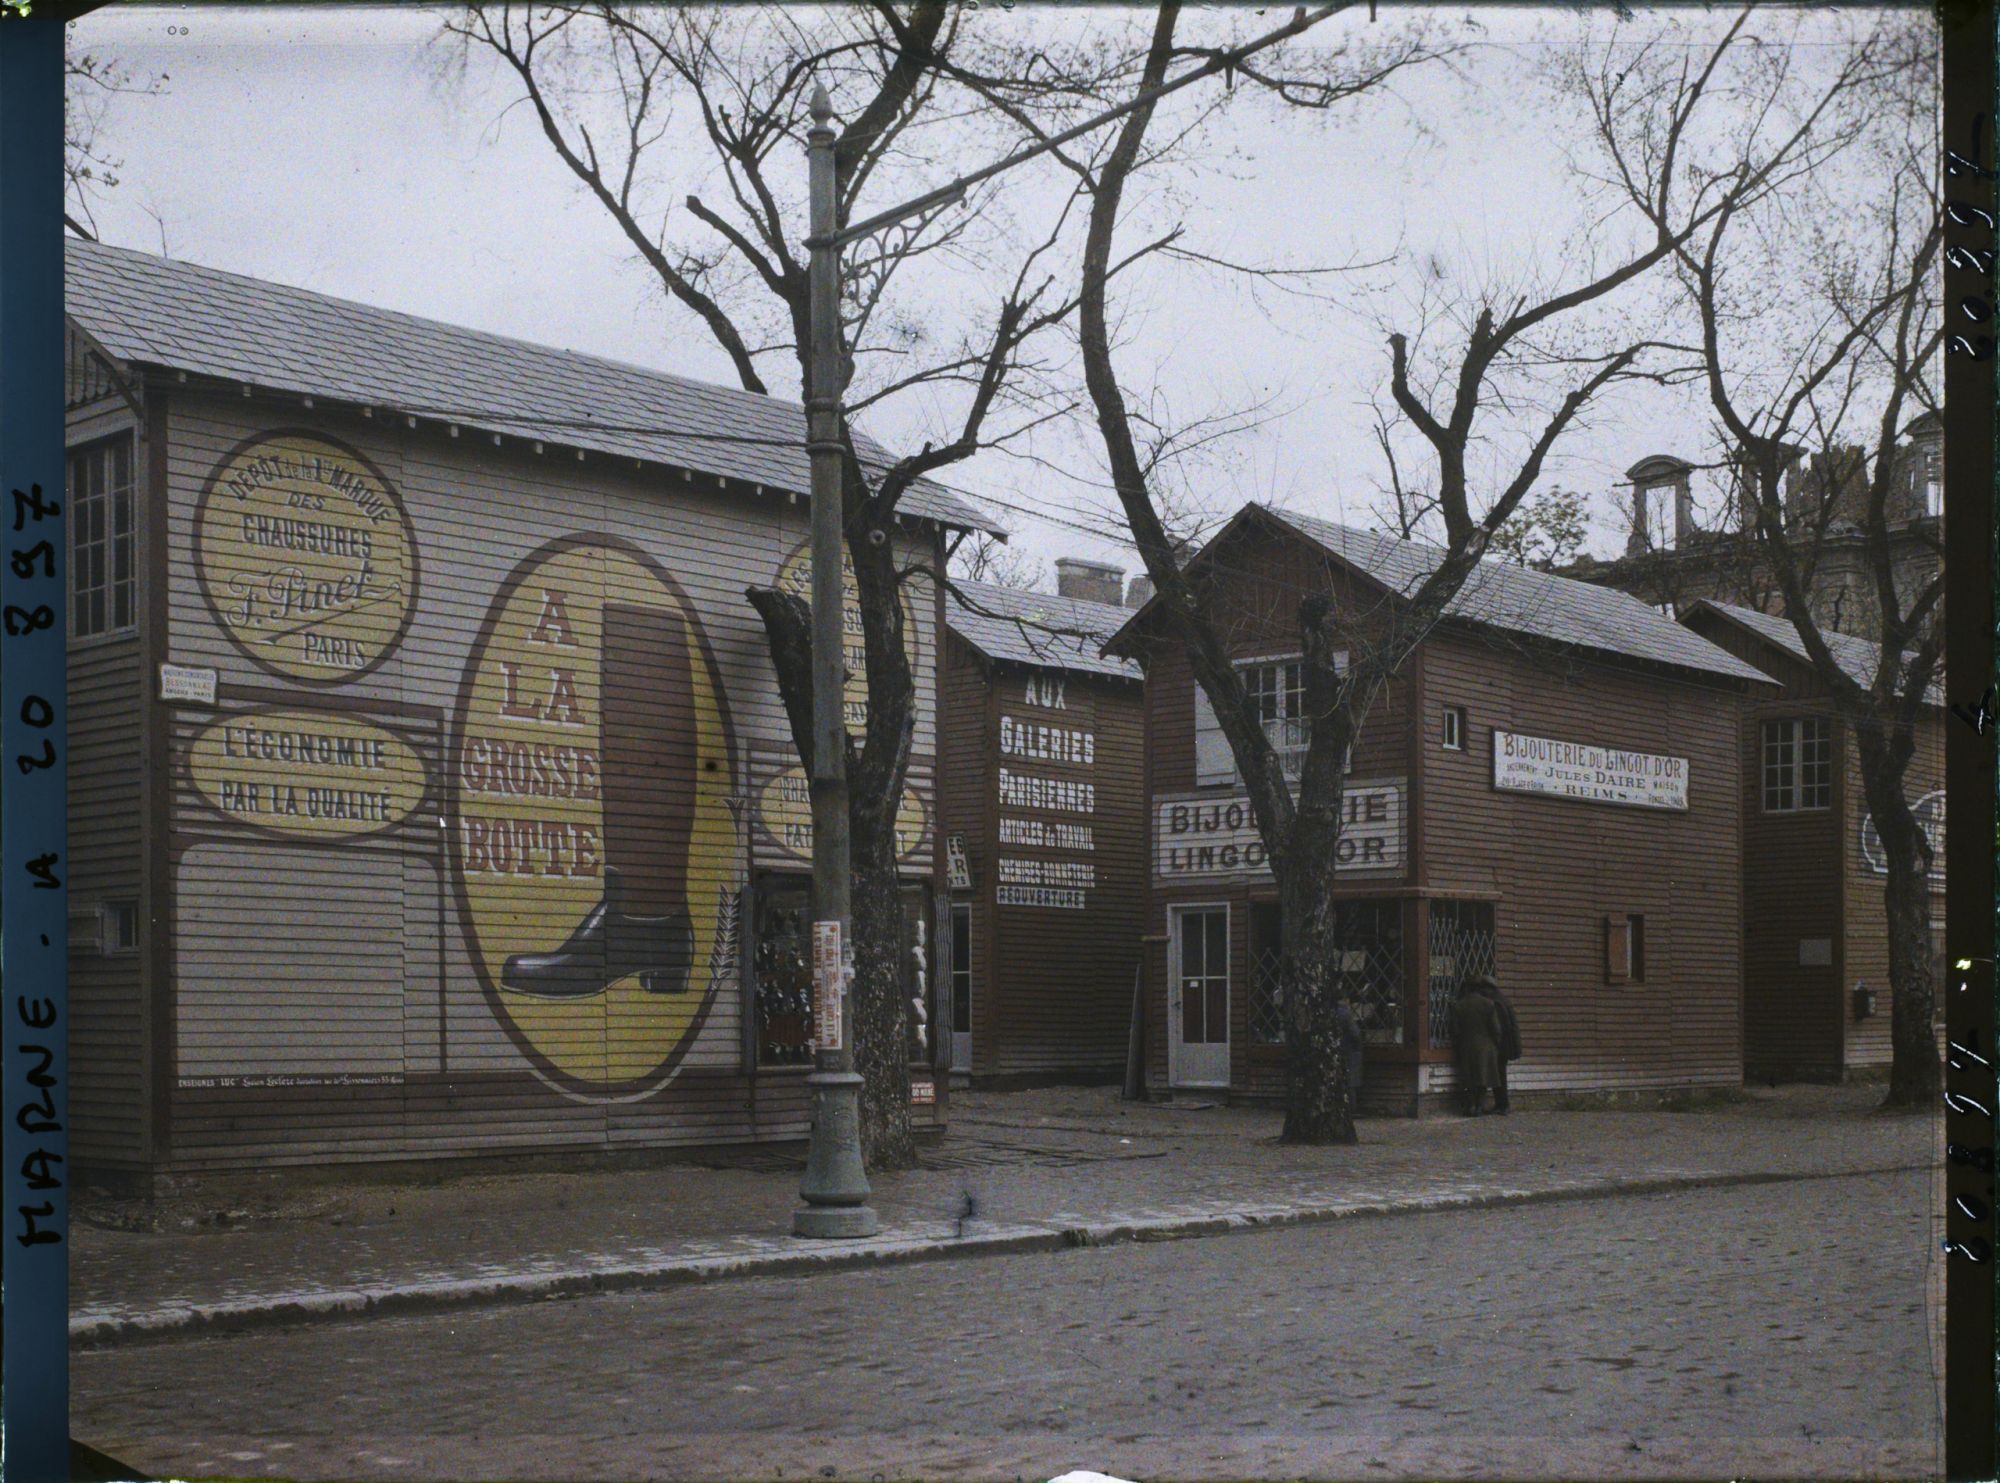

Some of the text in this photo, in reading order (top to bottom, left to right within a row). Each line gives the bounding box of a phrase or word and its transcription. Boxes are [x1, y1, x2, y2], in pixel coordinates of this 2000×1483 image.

[286, 457, 298, 478] de
[302, 455, 312, 479] la
[329, 464, 391, 525] MARQUE
[288, 492, 325, 510] DES
[5, 484, 61, 636] 897
[243, 514, 372, 559] CHAUSSURES
[267, 560, 397, 620] Pinet
[528, 588, 579, 649] A
[303, 632, 365, 669] PARIS
[499, 661, 586, 728] LA
[1025, 674, 1067, 710] AUX
[24, 696, 55, 771] 20
[223, 722, 386, 771] L'ÉCONOMIE
[1000, 716, 1094, 764] GALERIES
[1503, 733, 1681, 778] BIJOUTERIE DU LINGOT D'OR
[461, 737, 601, 801] GROSSE
[1000, 768, 1094, 812] PARISIENNES
[1545, 767, 1590, 782] JULES
[1596, 771, 1646, 789] DAIRE
[1565, 784, 1627, 800] REIMS
[220, 780, 392, 823] PAR LA QUALITÉ
[462, 815, 599, 880] BOTTE
[999, 818, 1094, 850] ARTICLES de TRAVAIL
[15, 996, 62, 1247] MARNE
